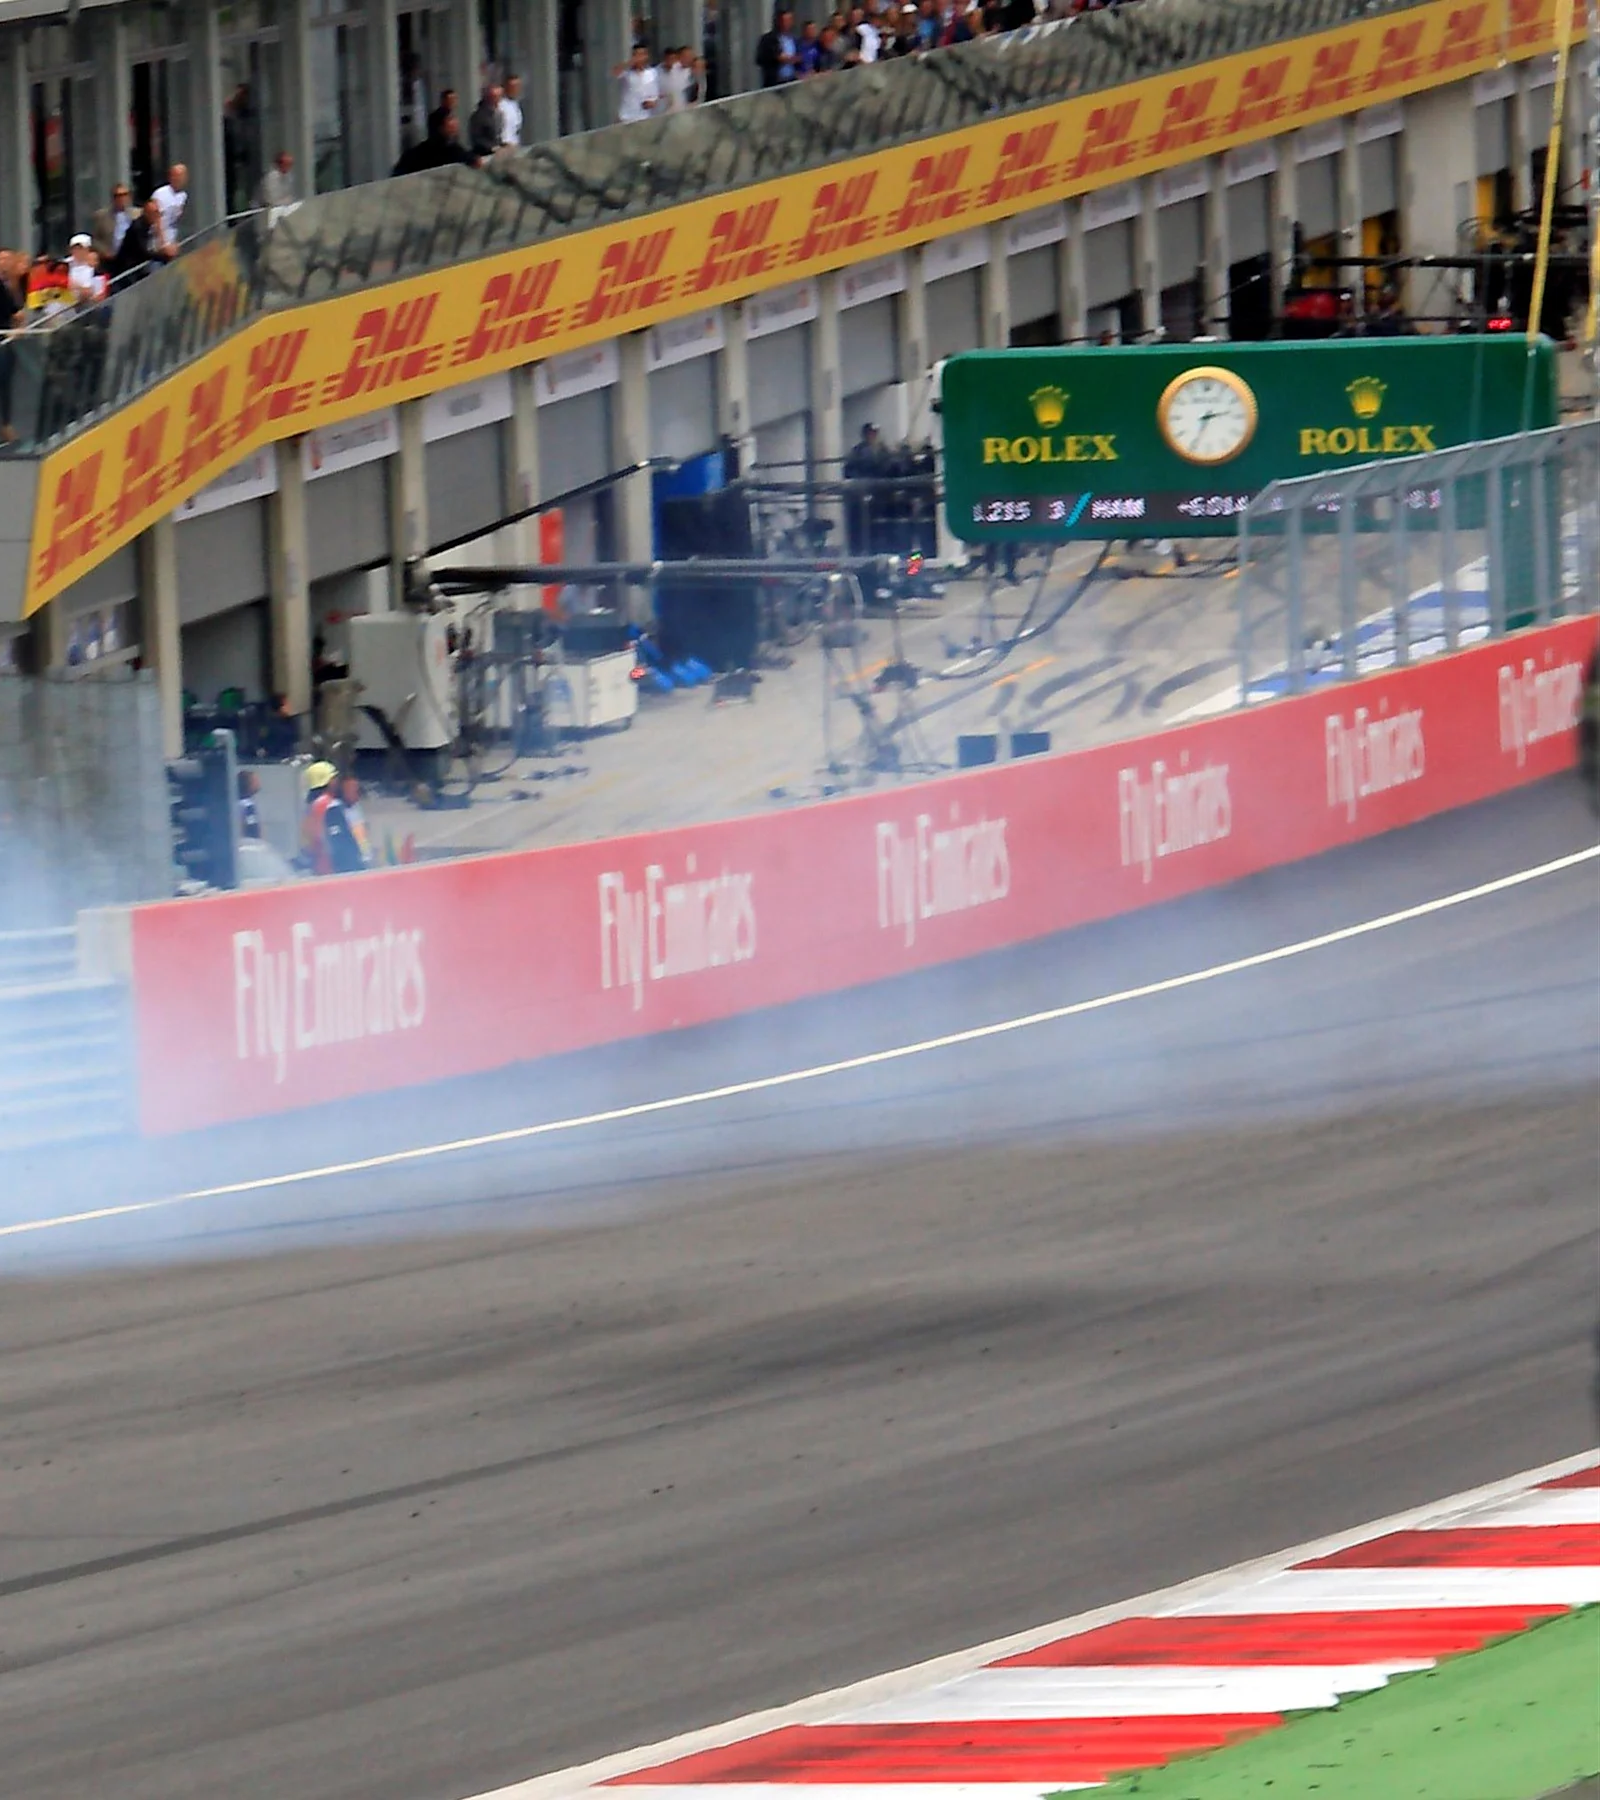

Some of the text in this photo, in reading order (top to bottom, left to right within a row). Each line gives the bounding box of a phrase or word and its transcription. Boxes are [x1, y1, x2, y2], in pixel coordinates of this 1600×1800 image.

[983, 433, 1120, 465] ROLEX
[1299, 425, 1437, 455] ROLEX
[1119, 749, 1232, 885] Fly Emirates
[1326, 696, 1425, 823] Fly Emirates
[598, 852, 757, 1012] Fly Emirates
[876, 801, 1010, 948] Fly Emirates
[234, 907, 426, 1085] Fly Emirates
